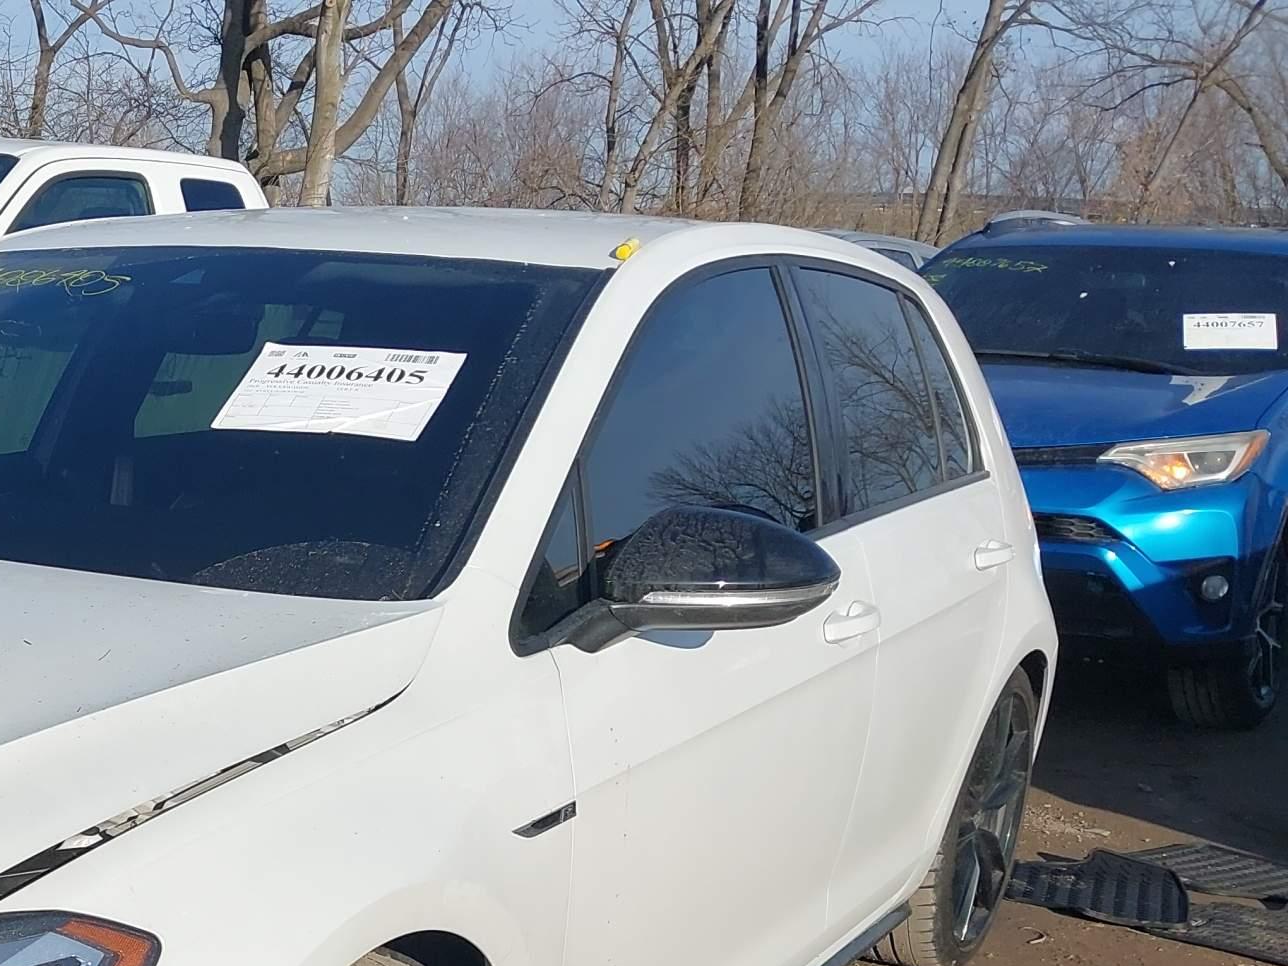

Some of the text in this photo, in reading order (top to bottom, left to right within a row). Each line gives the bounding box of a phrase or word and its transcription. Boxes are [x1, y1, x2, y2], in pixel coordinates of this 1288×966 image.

[1192, 320, 1264, 328] 44007657
[266, 363, 429, 385] 44006405
[249, 377, 295, 386] Progressive
[333, 380, 374, 388] Insurance
